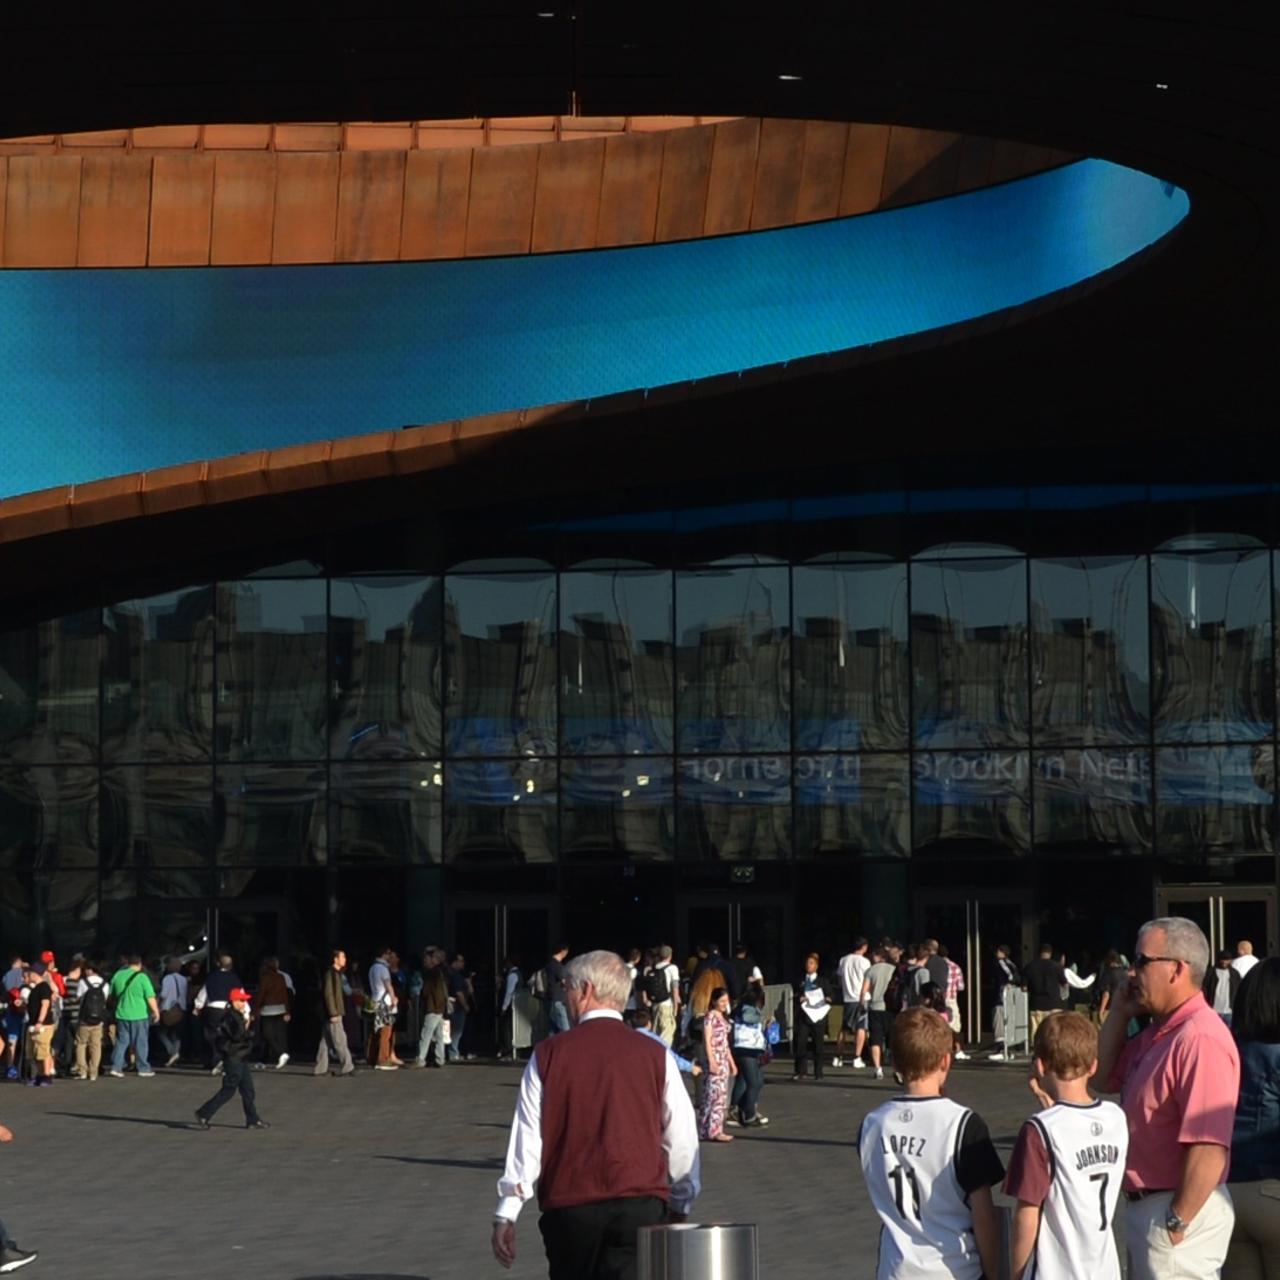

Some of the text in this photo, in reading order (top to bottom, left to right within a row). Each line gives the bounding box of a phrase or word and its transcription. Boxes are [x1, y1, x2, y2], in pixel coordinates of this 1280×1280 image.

[880, 1134, 927, 1157] LOPEZ
[1075, 1143, 1120, 1171] JOHNSON
[888, 1164, 922, 1221] 11
[1089, 1172, 1110, 1232] 7
